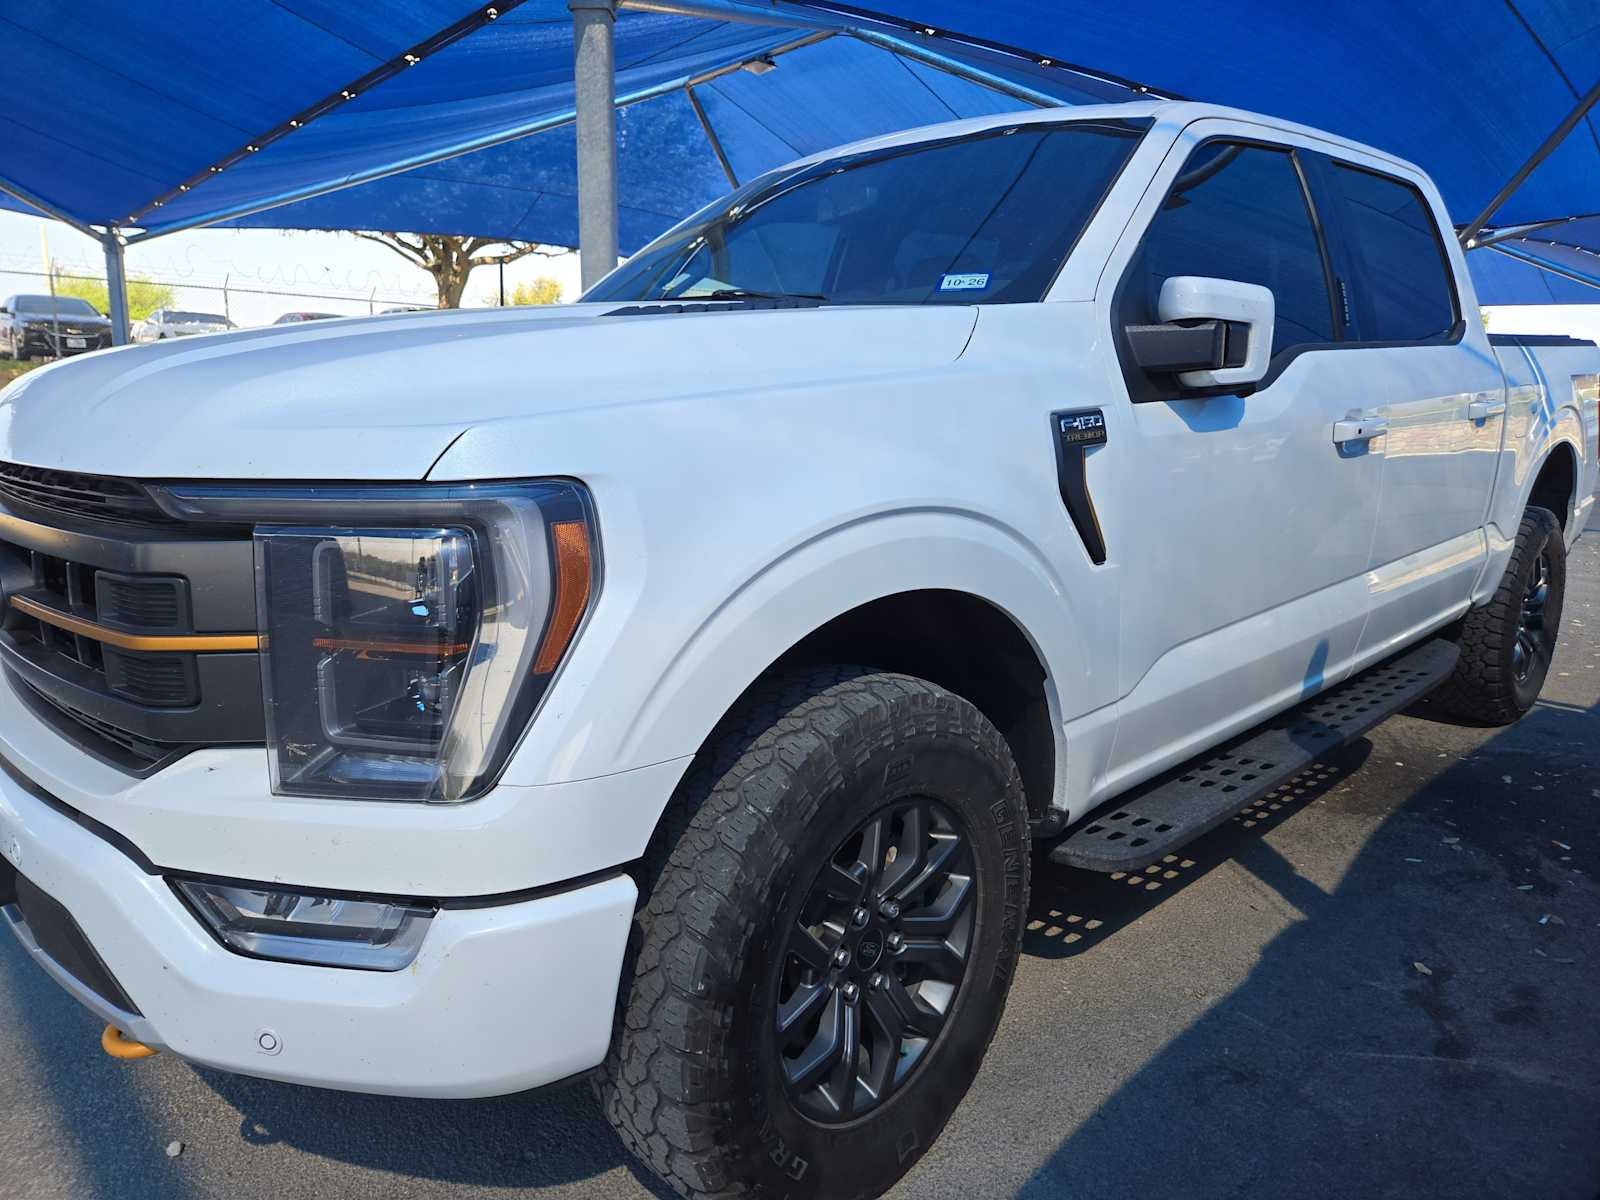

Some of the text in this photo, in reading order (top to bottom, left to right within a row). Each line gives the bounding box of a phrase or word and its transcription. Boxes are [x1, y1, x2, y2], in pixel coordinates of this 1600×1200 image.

[947, 278, 985, 287] 10 26
[989, 799, 1020, 991] GENERAL
